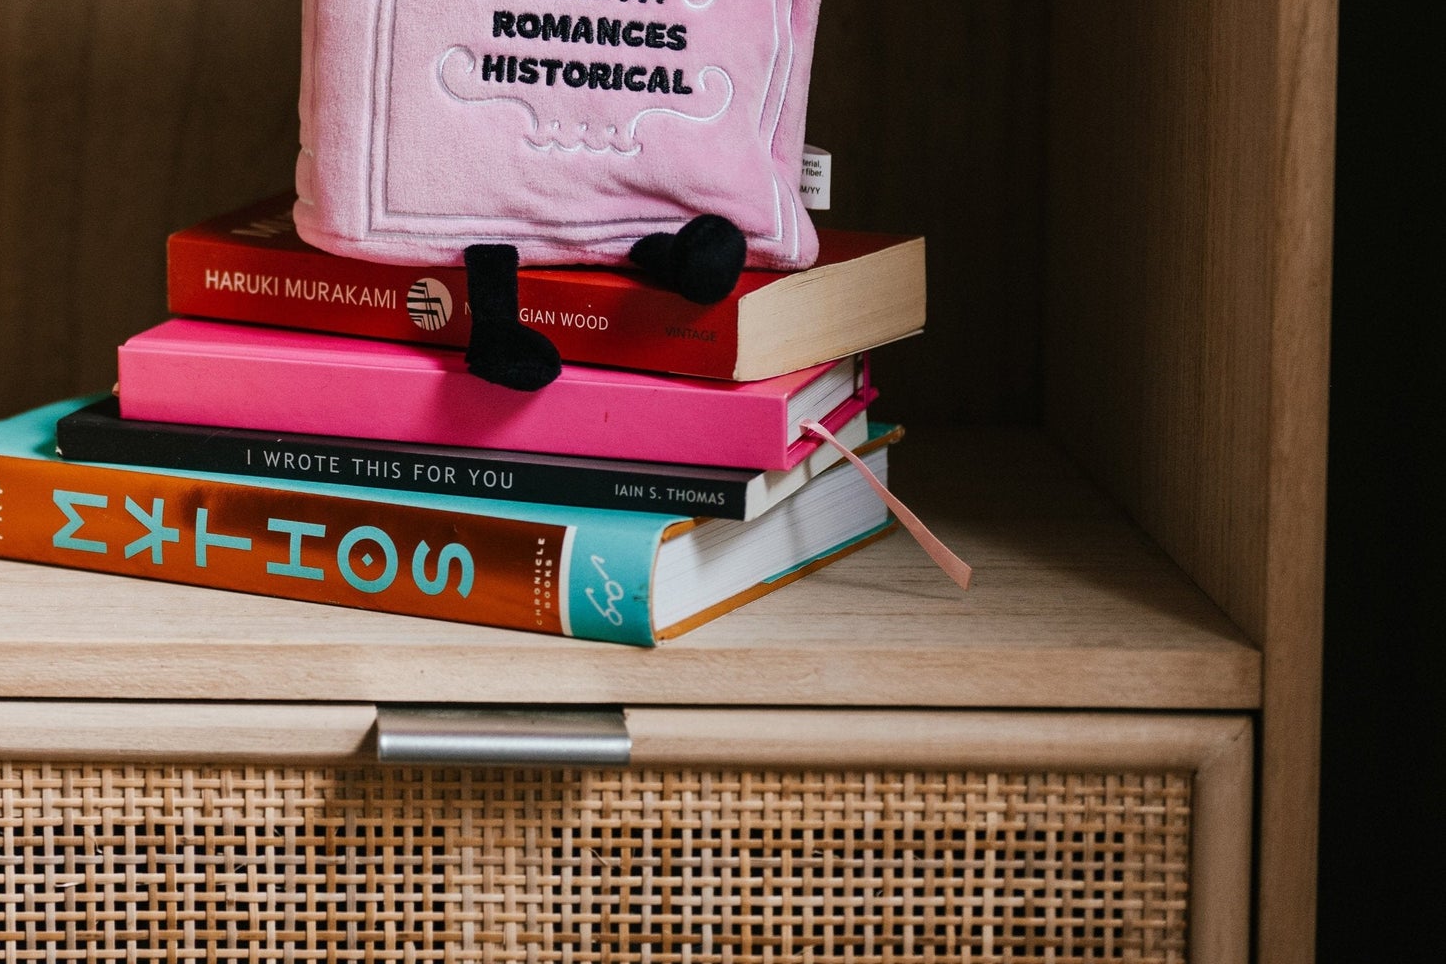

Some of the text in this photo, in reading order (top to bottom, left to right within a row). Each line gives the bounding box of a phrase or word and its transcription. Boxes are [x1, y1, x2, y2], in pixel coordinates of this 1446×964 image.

[492, 10, 687, 51] ROMANCES
[482, 54, 693, 95] HISTORICAL
[802, 159, 822, 169] terial,
[205, 269, 397, 310] HARUKI MURAKAMI
[560, 312, 609, 331] WOOD
[665, 326, 717, 342] VINTAGE
[246, 449, 725, 505] I WROTE THIS FOR YOU IAIN S. THOMAS
[52, 489, 475, 599] MYTHOS
[534, 538, 545, 626] CHRONICLE
[544, 559, 552, 609] BOOKS
